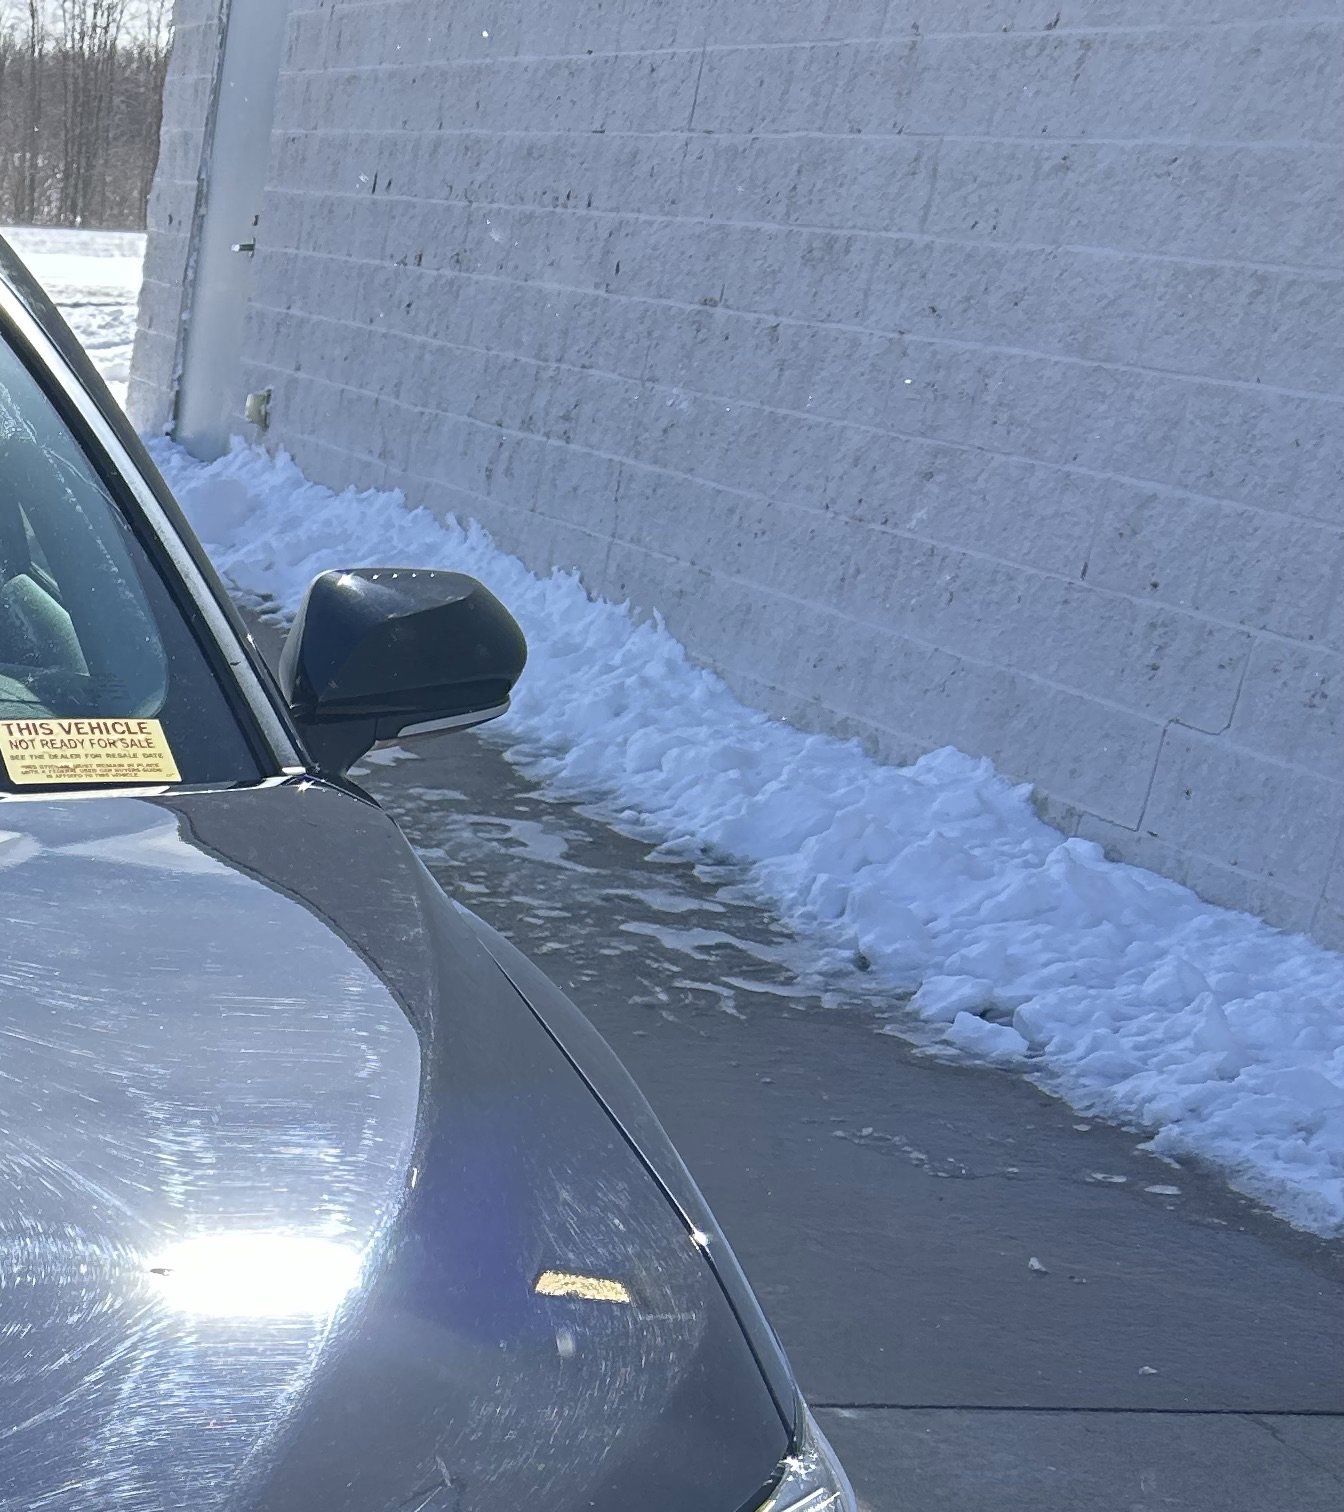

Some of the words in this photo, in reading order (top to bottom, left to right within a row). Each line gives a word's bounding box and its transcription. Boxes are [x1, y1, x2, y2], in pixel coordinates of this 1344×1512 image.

[1, 722, 54, 736] THIS
[57, 721, 152, 735] VEHICLE
[9, 739, 35, 750] NOT
[39, 738, 85, 750] READY
[88, 738, 118, 749] FOR
[120, 738, 156, 749] SALE
